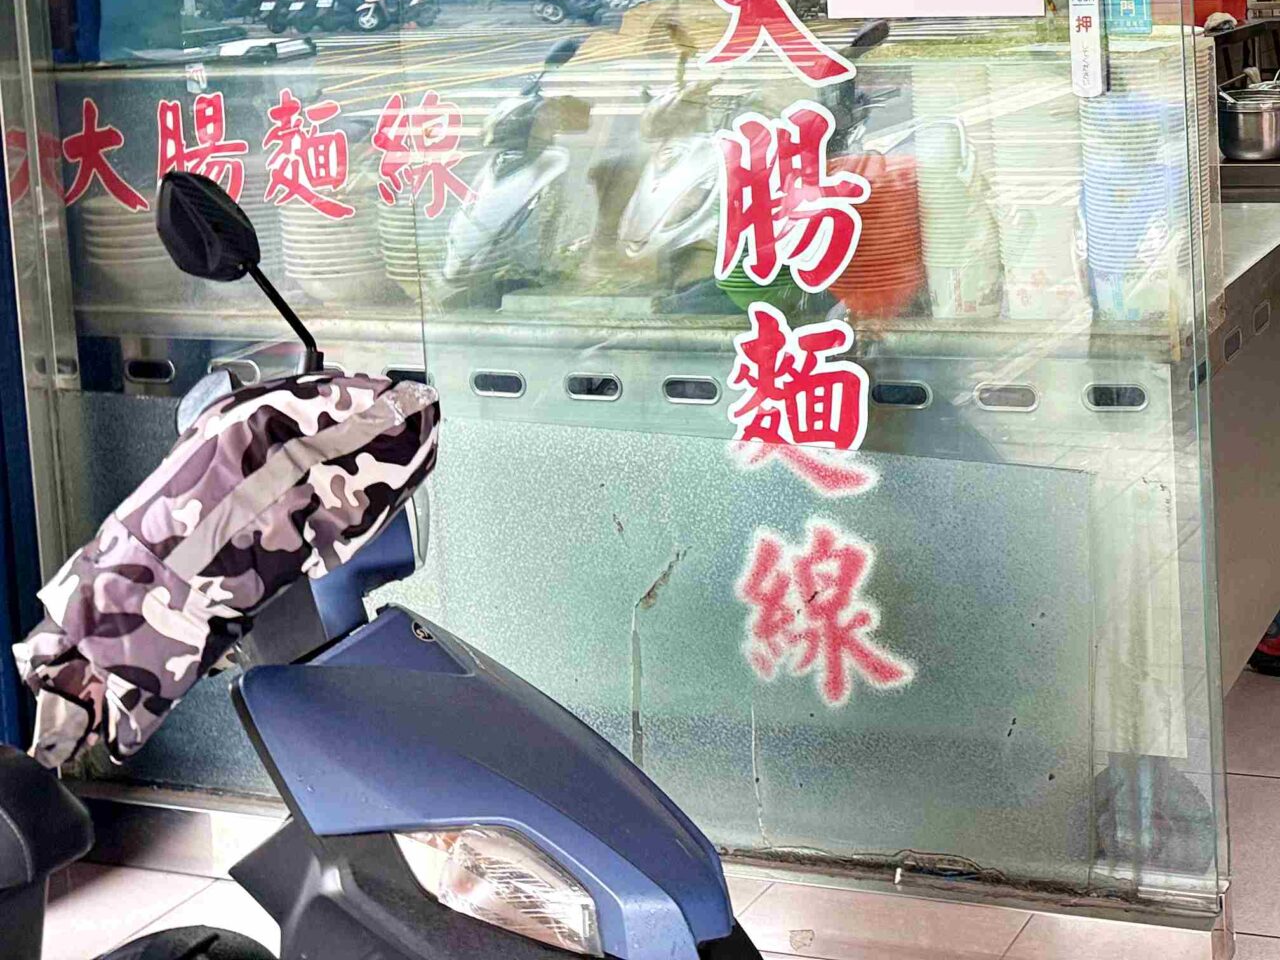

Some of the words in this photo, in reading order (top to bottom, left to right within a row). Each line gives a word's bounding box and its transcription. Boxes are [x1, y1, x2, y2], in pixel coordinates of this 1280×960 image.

[1075, 15, 1093, 34] 押
[61, 88, 480, 222] 大腸麵線
